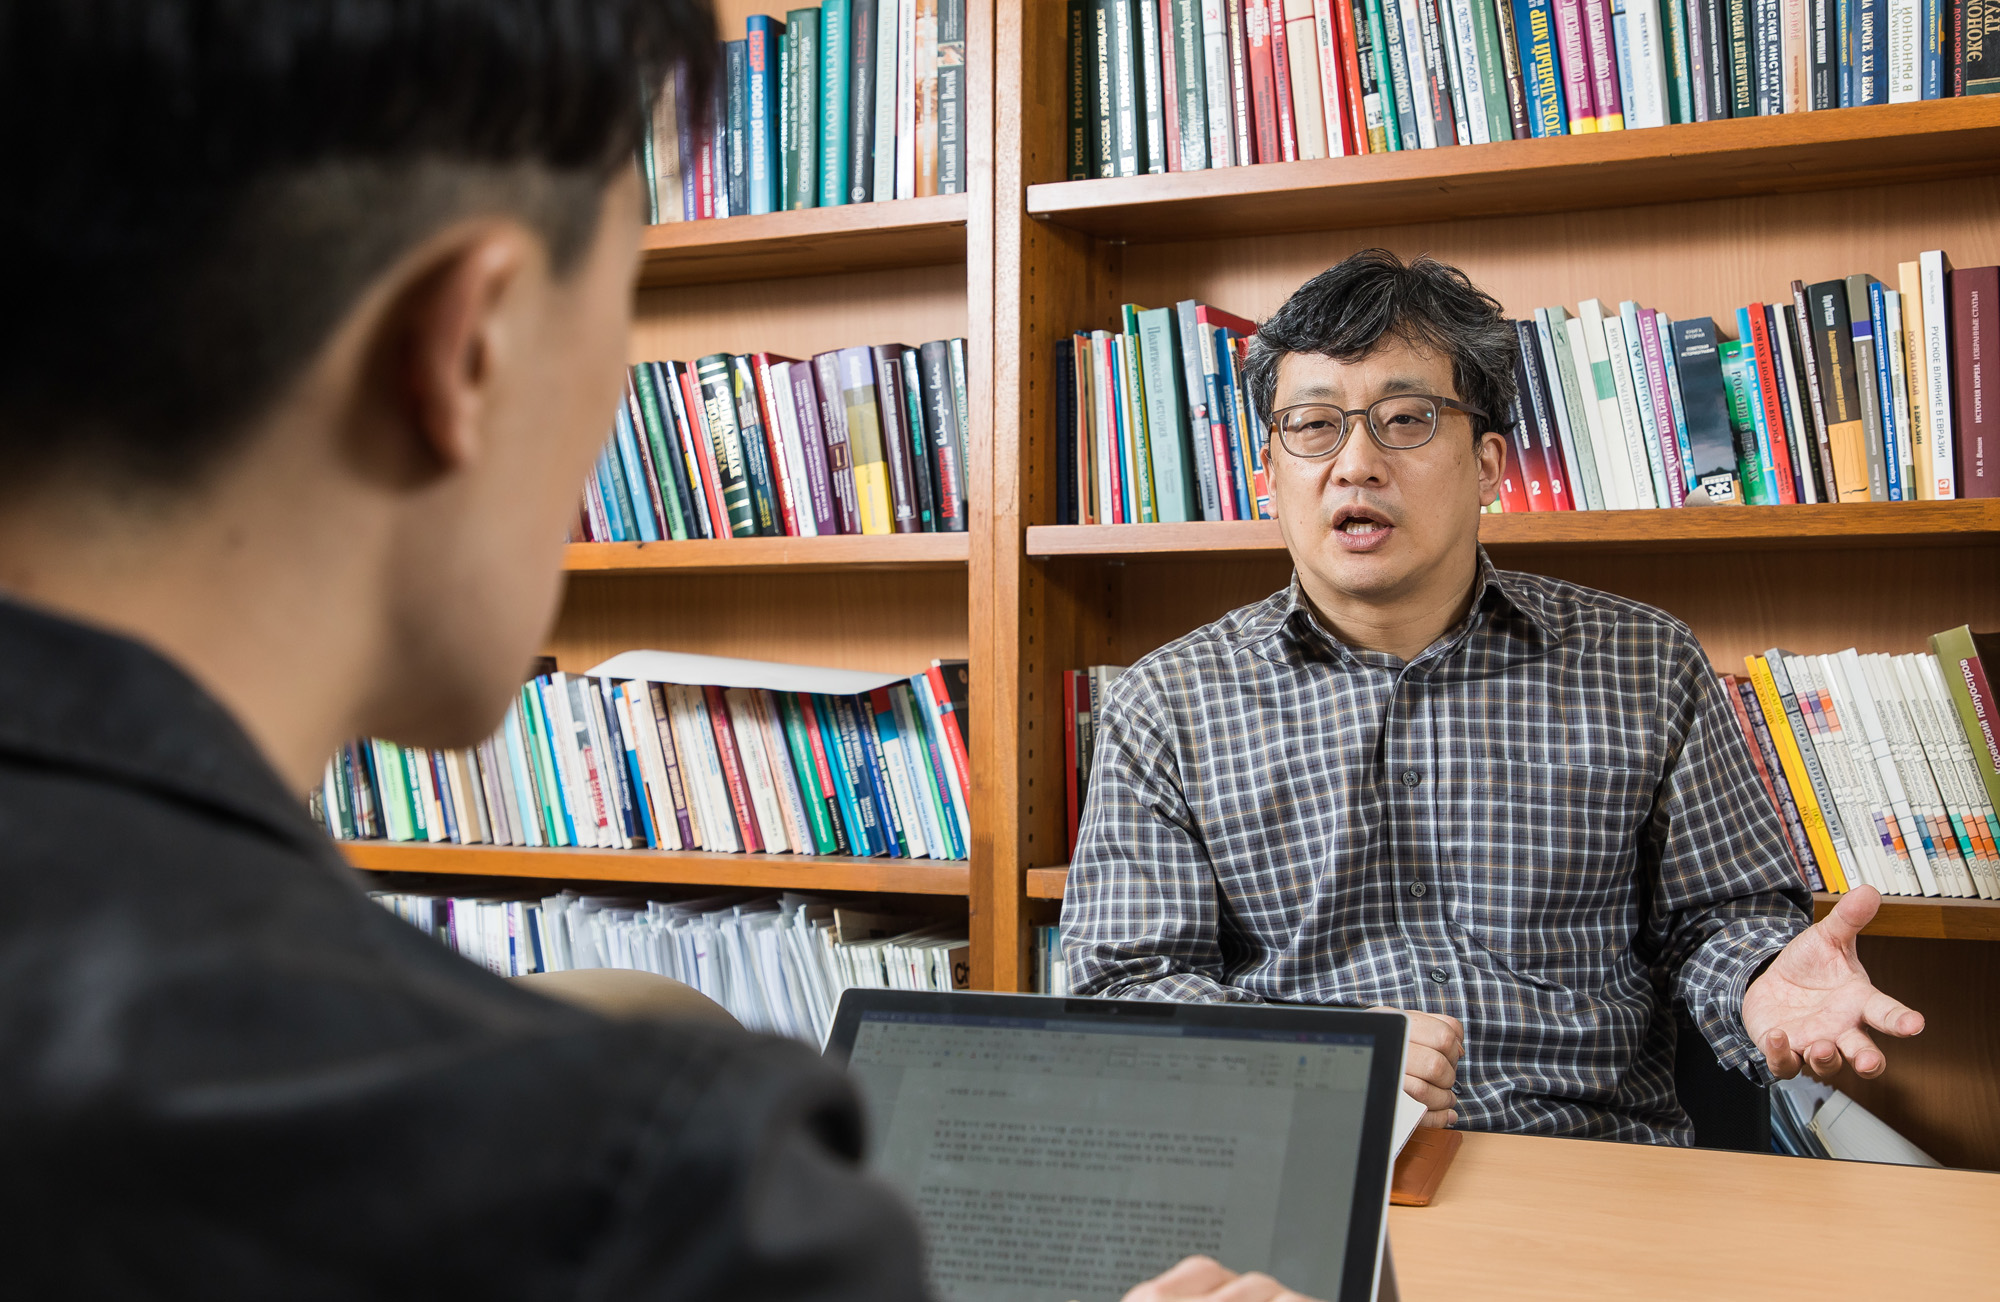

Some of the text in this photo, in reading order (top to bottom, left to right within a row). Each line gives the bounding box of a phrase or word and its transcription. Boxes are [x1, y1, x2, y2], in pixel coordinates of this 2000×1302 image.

[1457, 7, 1479, 94] КОРПОРАЦИИ ОБЩЕСТВО
[1529, 8, 1548, 41] МИР
[1861, 11, 1873, 51] ПОРОГЕ
[1897, 6, 1914, 79] РЫНОЧНОЙ
[1953, 8, 1961, 64] ДОЛЛАРОВОЙ
[1072, 9, 1084, 165] РОССИЯ РЕФОРМИРУЮЩАЯСЯ
[1389, 43, 1411, 114] ГРАЖДАНСКОЕ
[1733, 40, 1751, 108] ГЛОБАЛИЗАЦИЯ
[1768, 44, 1779, 115] ИНСТИТУТЫ
[1861, 76, 1873, 102] ВЕКА
[748, 29, 764, 180] СССР после распада
[824, 10, 839, 197] ГРАНИ ГЛОБАЛИЗАЦИИ
[1971, 290, 1979, 317] СТАТЬИ
[1907, 330, 1917, 360] РОССИЯ
[1930, 326, 1940, 363] РУССКОЕ
[1972, 318, 1980, 359] ИЗБРАННЫЕ
[1146, 326, 1167, 438] Политическая история
[1644, 316, 1672, 432] БЮДЖЕТНЫЙ АНАЛИЗ
[1753, 319, 1780, 444] РОССИЯ НА ПОРОГЕ XXI ВЕКА
[1871, 289, 1898, 483] Социальный портрет современного казахстанского общества
[1910, 369, 1920, 395] КИТАЙ
[1932, 365, 1943, 407] ВЛИЯНИЕ
[1609, 327, 1648, 497] ПОСТСОВЕТСКАЯ ЦЕНТРАЛЬНАЯ АЗИЯ
[1632, 340, 1663, 474] РУССКАЯ МОЛОДЕЖЬ
[1730, 370, 1760, 484] РОССИЯ В ЦИФРАХ
[1913, 411, 1923, 444] ЕВРАЗИИ
[1974, 389, 1982, 422] ИСТОРИЯ
[1936, 418, 1945, 457] ЕВРАЗИИ
[938, 446, 957, 517] Афганистан
[1504, 478, 1512, 492] 1
[1531, 480, 1541, 495] 2
[1551, 479, 1561, 493] 3
[1977, 467, 1983, 476] Ю.
[1750, 672, 1769, 705] РОССИИ
[1761, 672, 1786, 724] МИР РОССИИ
[1959, 658, 1986, 718] полуостров
[1829, 819, 1841, 838] МИР
